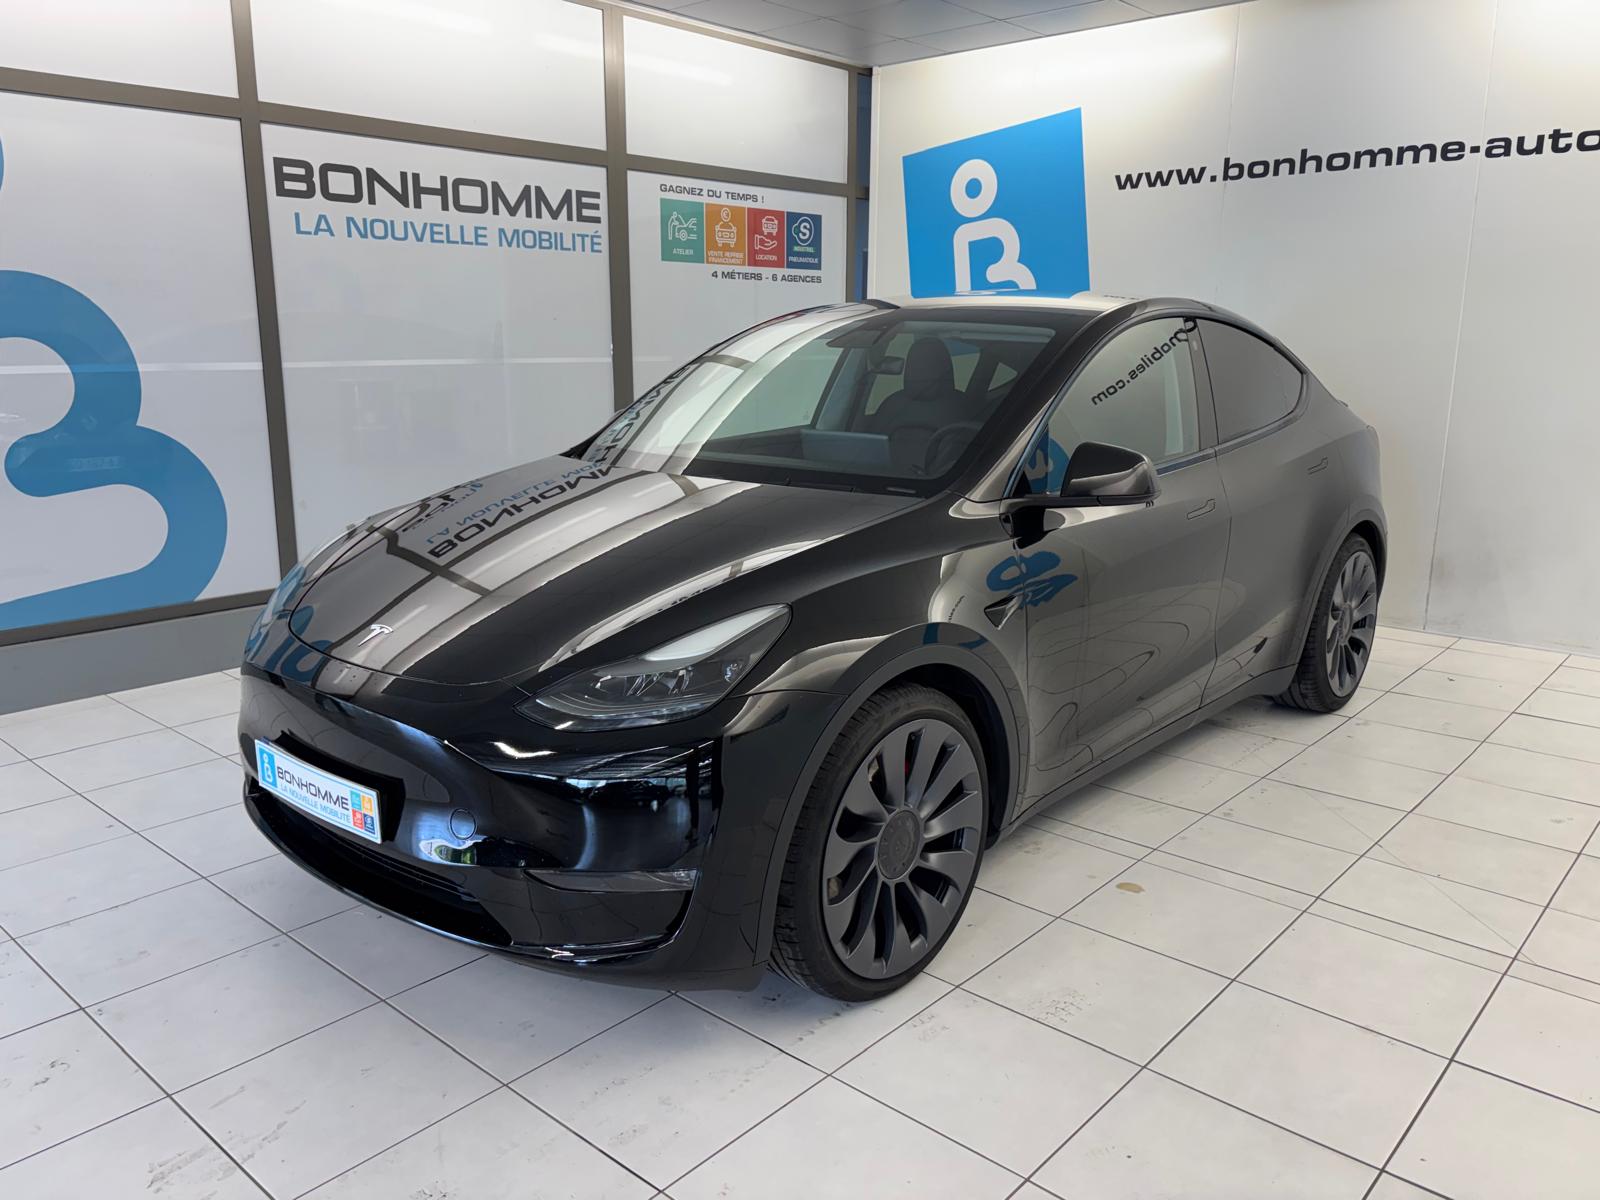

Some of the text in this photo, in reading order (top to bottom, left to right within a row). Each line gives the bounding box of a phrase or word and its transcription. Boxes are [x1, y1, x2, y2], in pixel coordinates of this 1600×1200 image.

[273, 156, 602, 225] BONHOMME
[660, 184, 704, 197] GAGNEZ
[707, 189, 722, 199] DU
[725, 191, 759, 203] TEMPS
[294, 212, 602, 254] LA NOUVELLE MOBILITÉ
[672, 248, 694, 256] ATELIER
[755, 254, 778, 262] LOCATION
[711, 271, 718, 279] 4
[721, 270, 763, 281] MÉTIERS
[771, 274, 778, 282] 6
[781, 275, 822, 284] AGENCES
[276, 765, 350, 811] BONHOMME
[280, 783, 288, 793] LA
[289, 787, 318, 808] NOUVELLE
